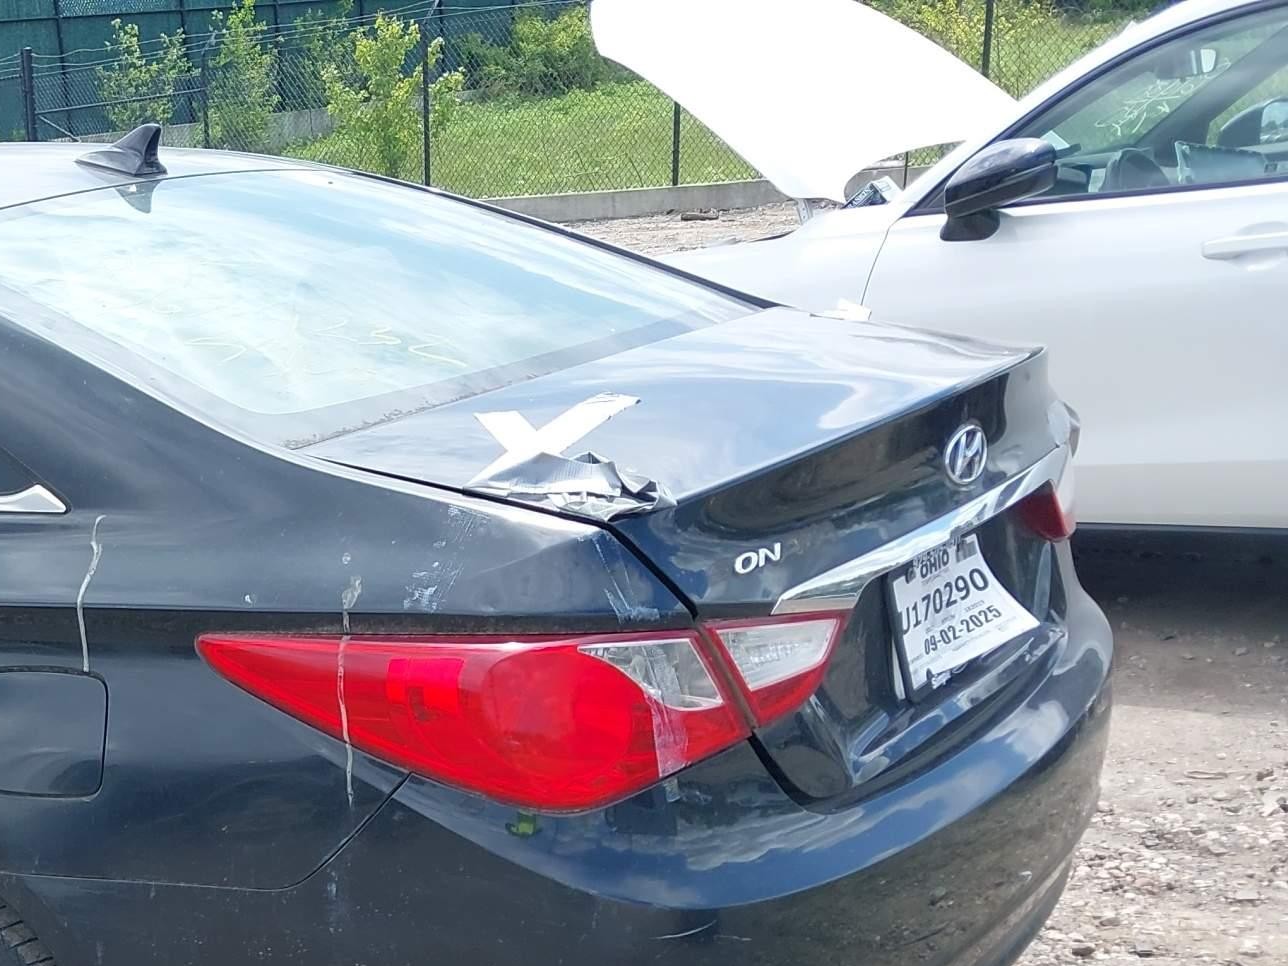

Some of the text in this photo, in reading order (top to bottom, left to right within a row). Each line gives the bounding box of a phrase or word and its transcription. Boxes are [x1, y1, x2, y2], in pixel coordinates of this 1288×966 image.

[734, 541, 782, 575] ON
[919, 548, 950, 579] OHIO
[923, 604, 1003, 656] 09-02-2025
